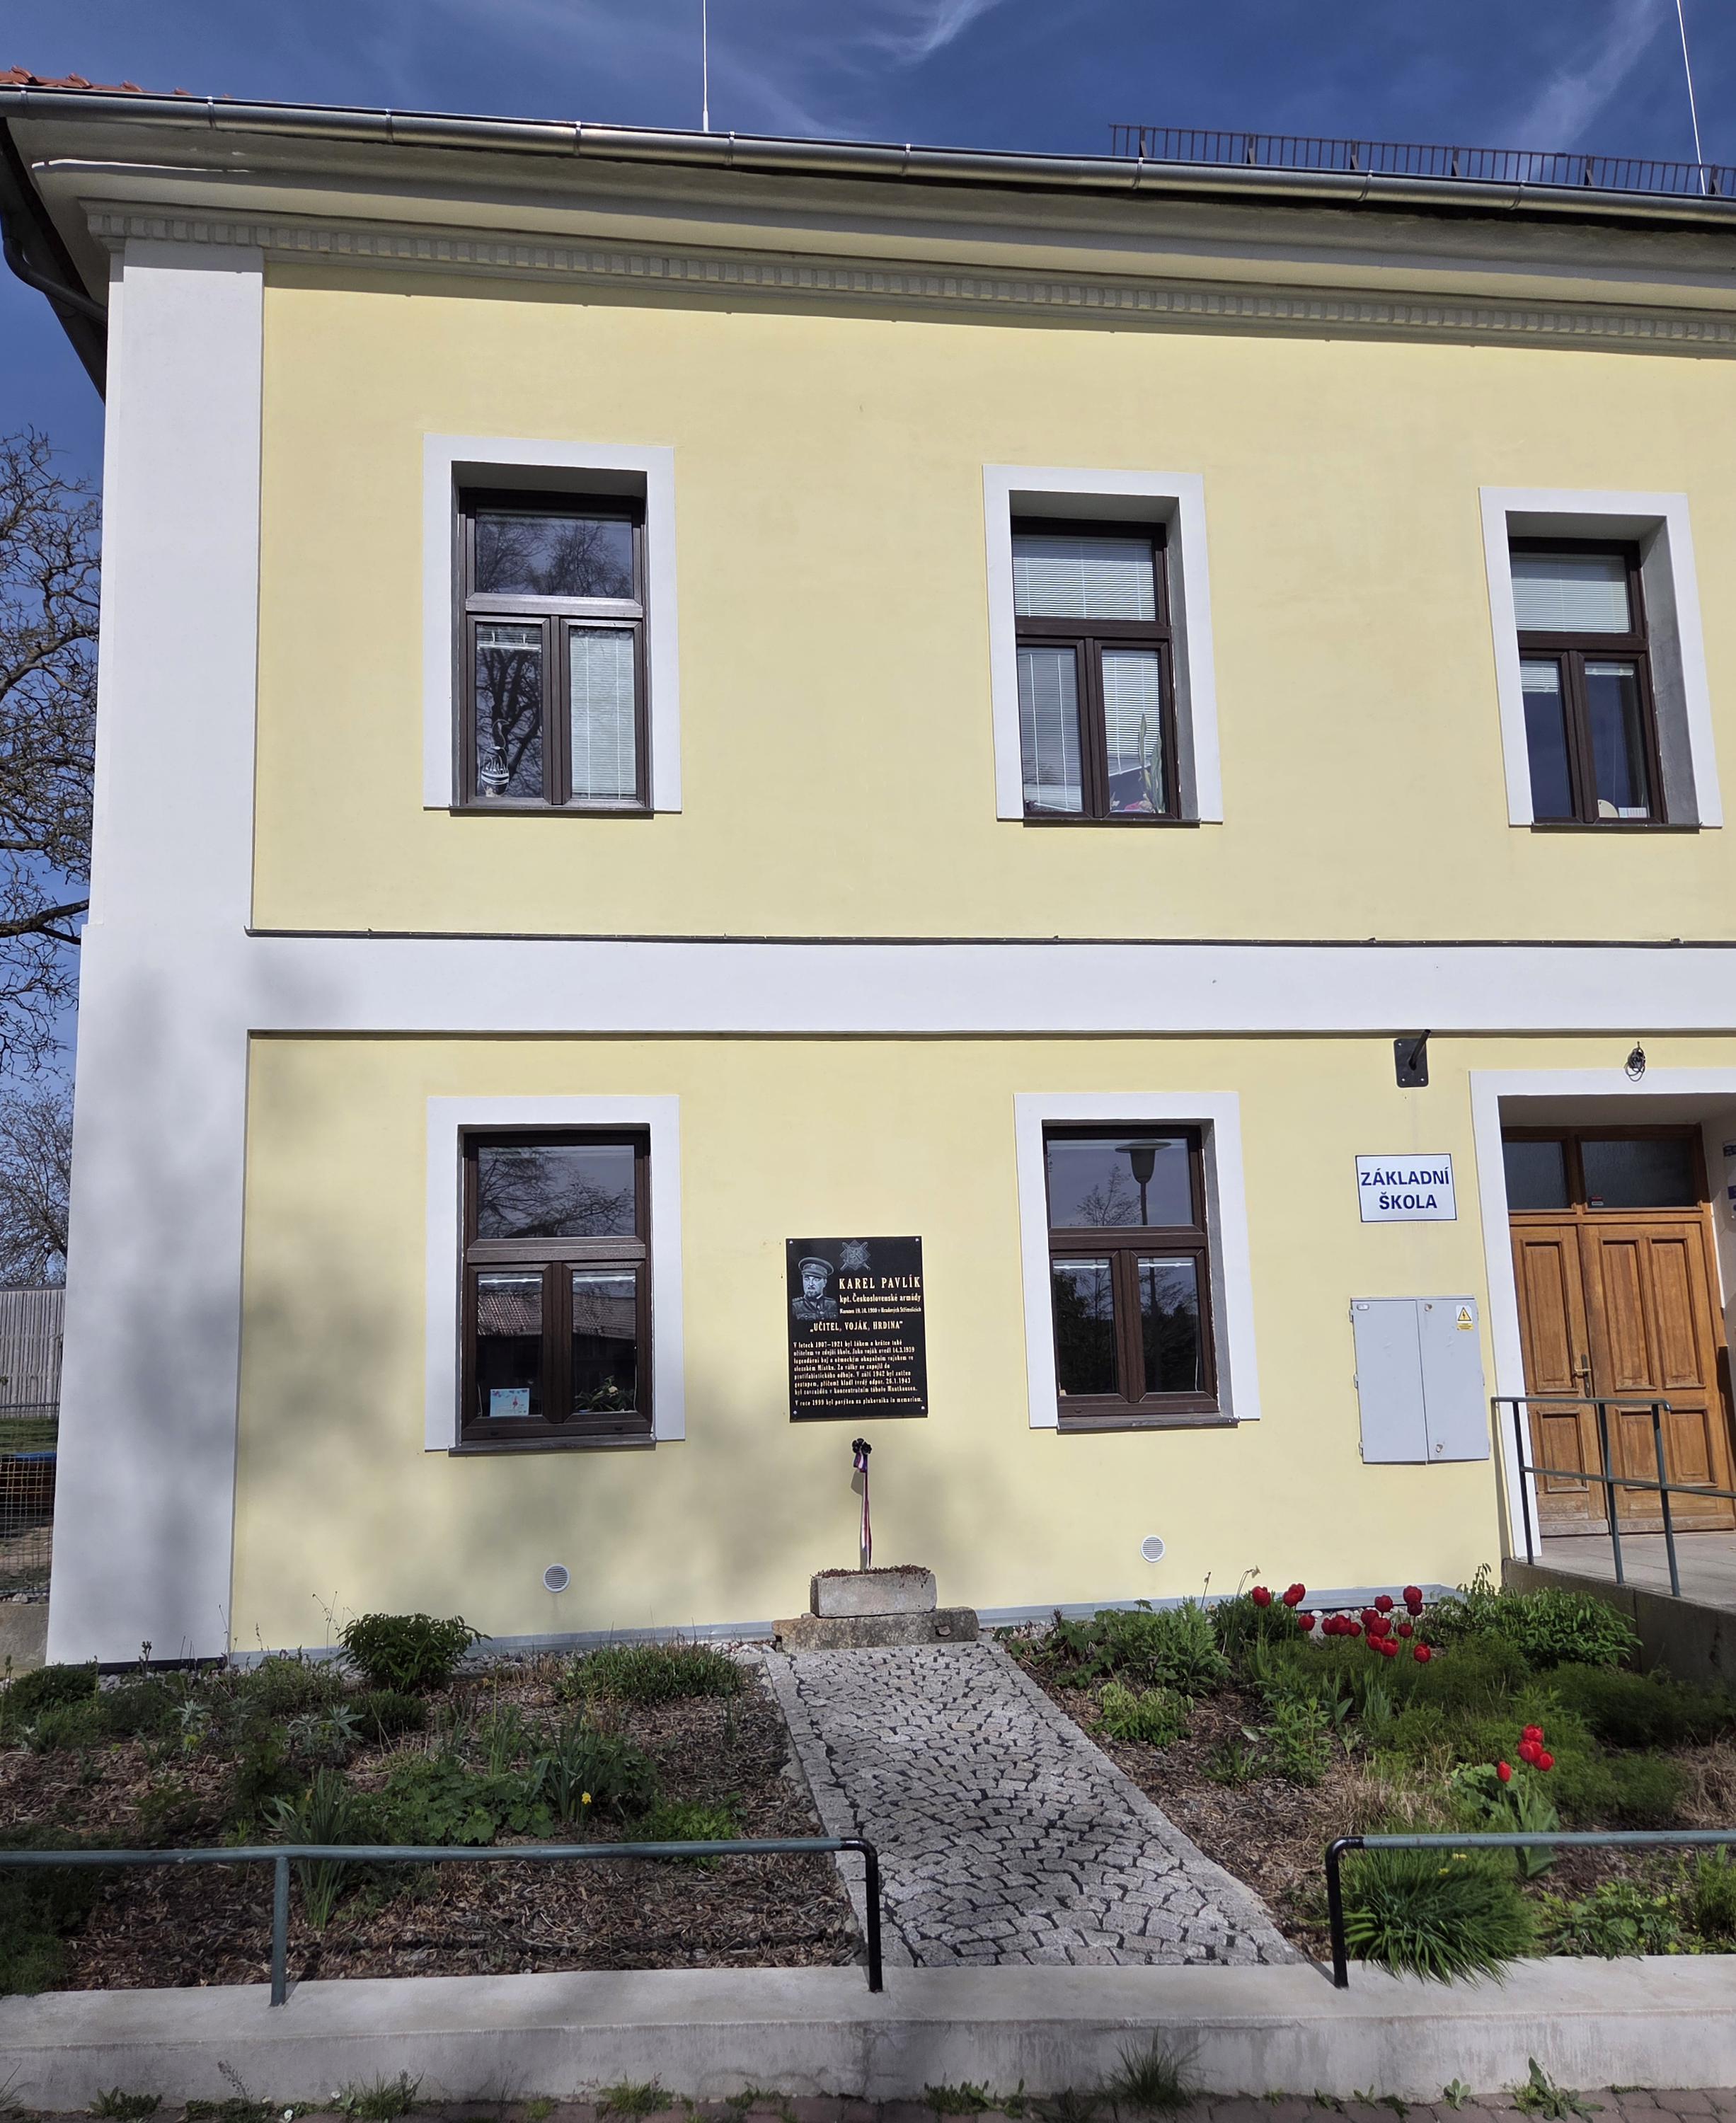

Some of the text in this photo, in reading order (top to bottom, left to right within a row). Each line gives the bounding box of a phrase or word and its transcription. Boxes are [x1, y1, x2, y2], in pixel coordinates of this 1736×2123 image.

[1360, 1166, 1449, 1186] ZÁKLADNÍ
[1379, 1191, 1437, 1209] ŠKOLA
[839, 1274, 921, 1289] KAREL PAVLÍK
[839, 1292, 921, 1304] kpt. Československé armády
[844, 1320, 870, 1330] VOJÁK,
